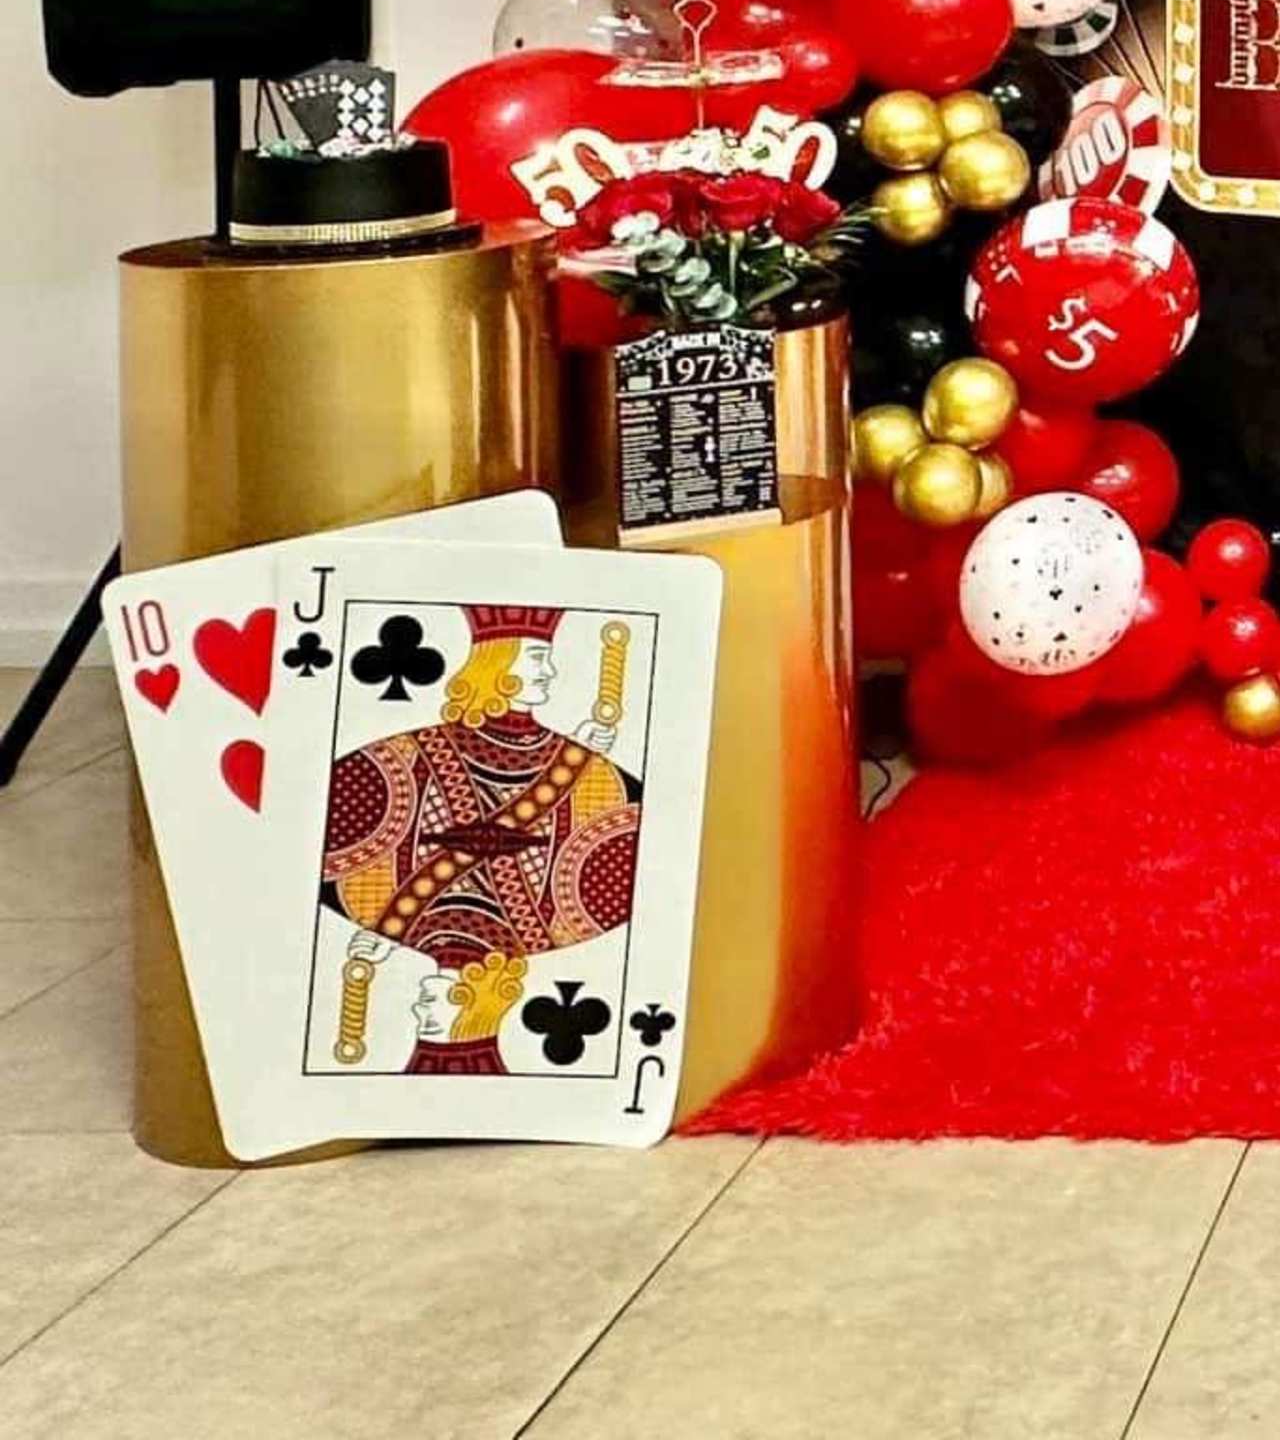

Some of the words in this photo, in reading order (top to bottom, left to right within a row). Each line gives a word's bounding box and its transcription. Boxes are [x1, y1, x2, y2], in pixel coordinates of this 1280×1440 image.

[1053, 109, 1127, 199] 100
[658, 354, 739, 386] 1973
[293, 566, 336, 624] J
[120, 599, 171, 662] 10
[623, 1054, 665, 1115] J
